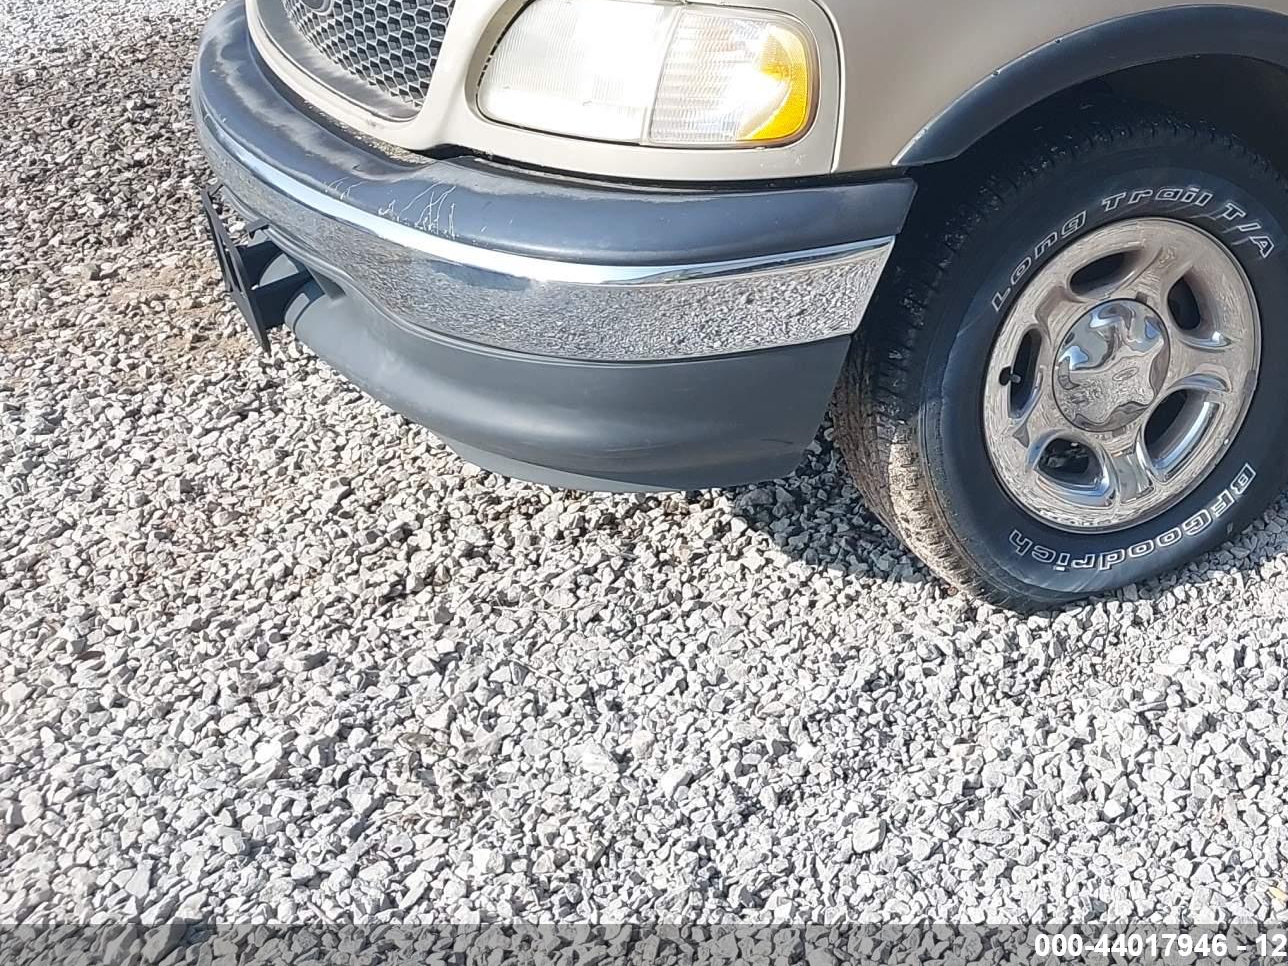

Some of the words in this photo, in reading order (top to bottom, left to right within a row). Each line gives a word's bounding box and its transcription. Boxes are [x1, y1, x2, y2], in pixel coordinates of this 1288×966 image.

[990, 210, 1088, 312] Long
[1102, 186, 1214, 212] Trail
[1008, 462, 1257, 572] BFGoodrich
